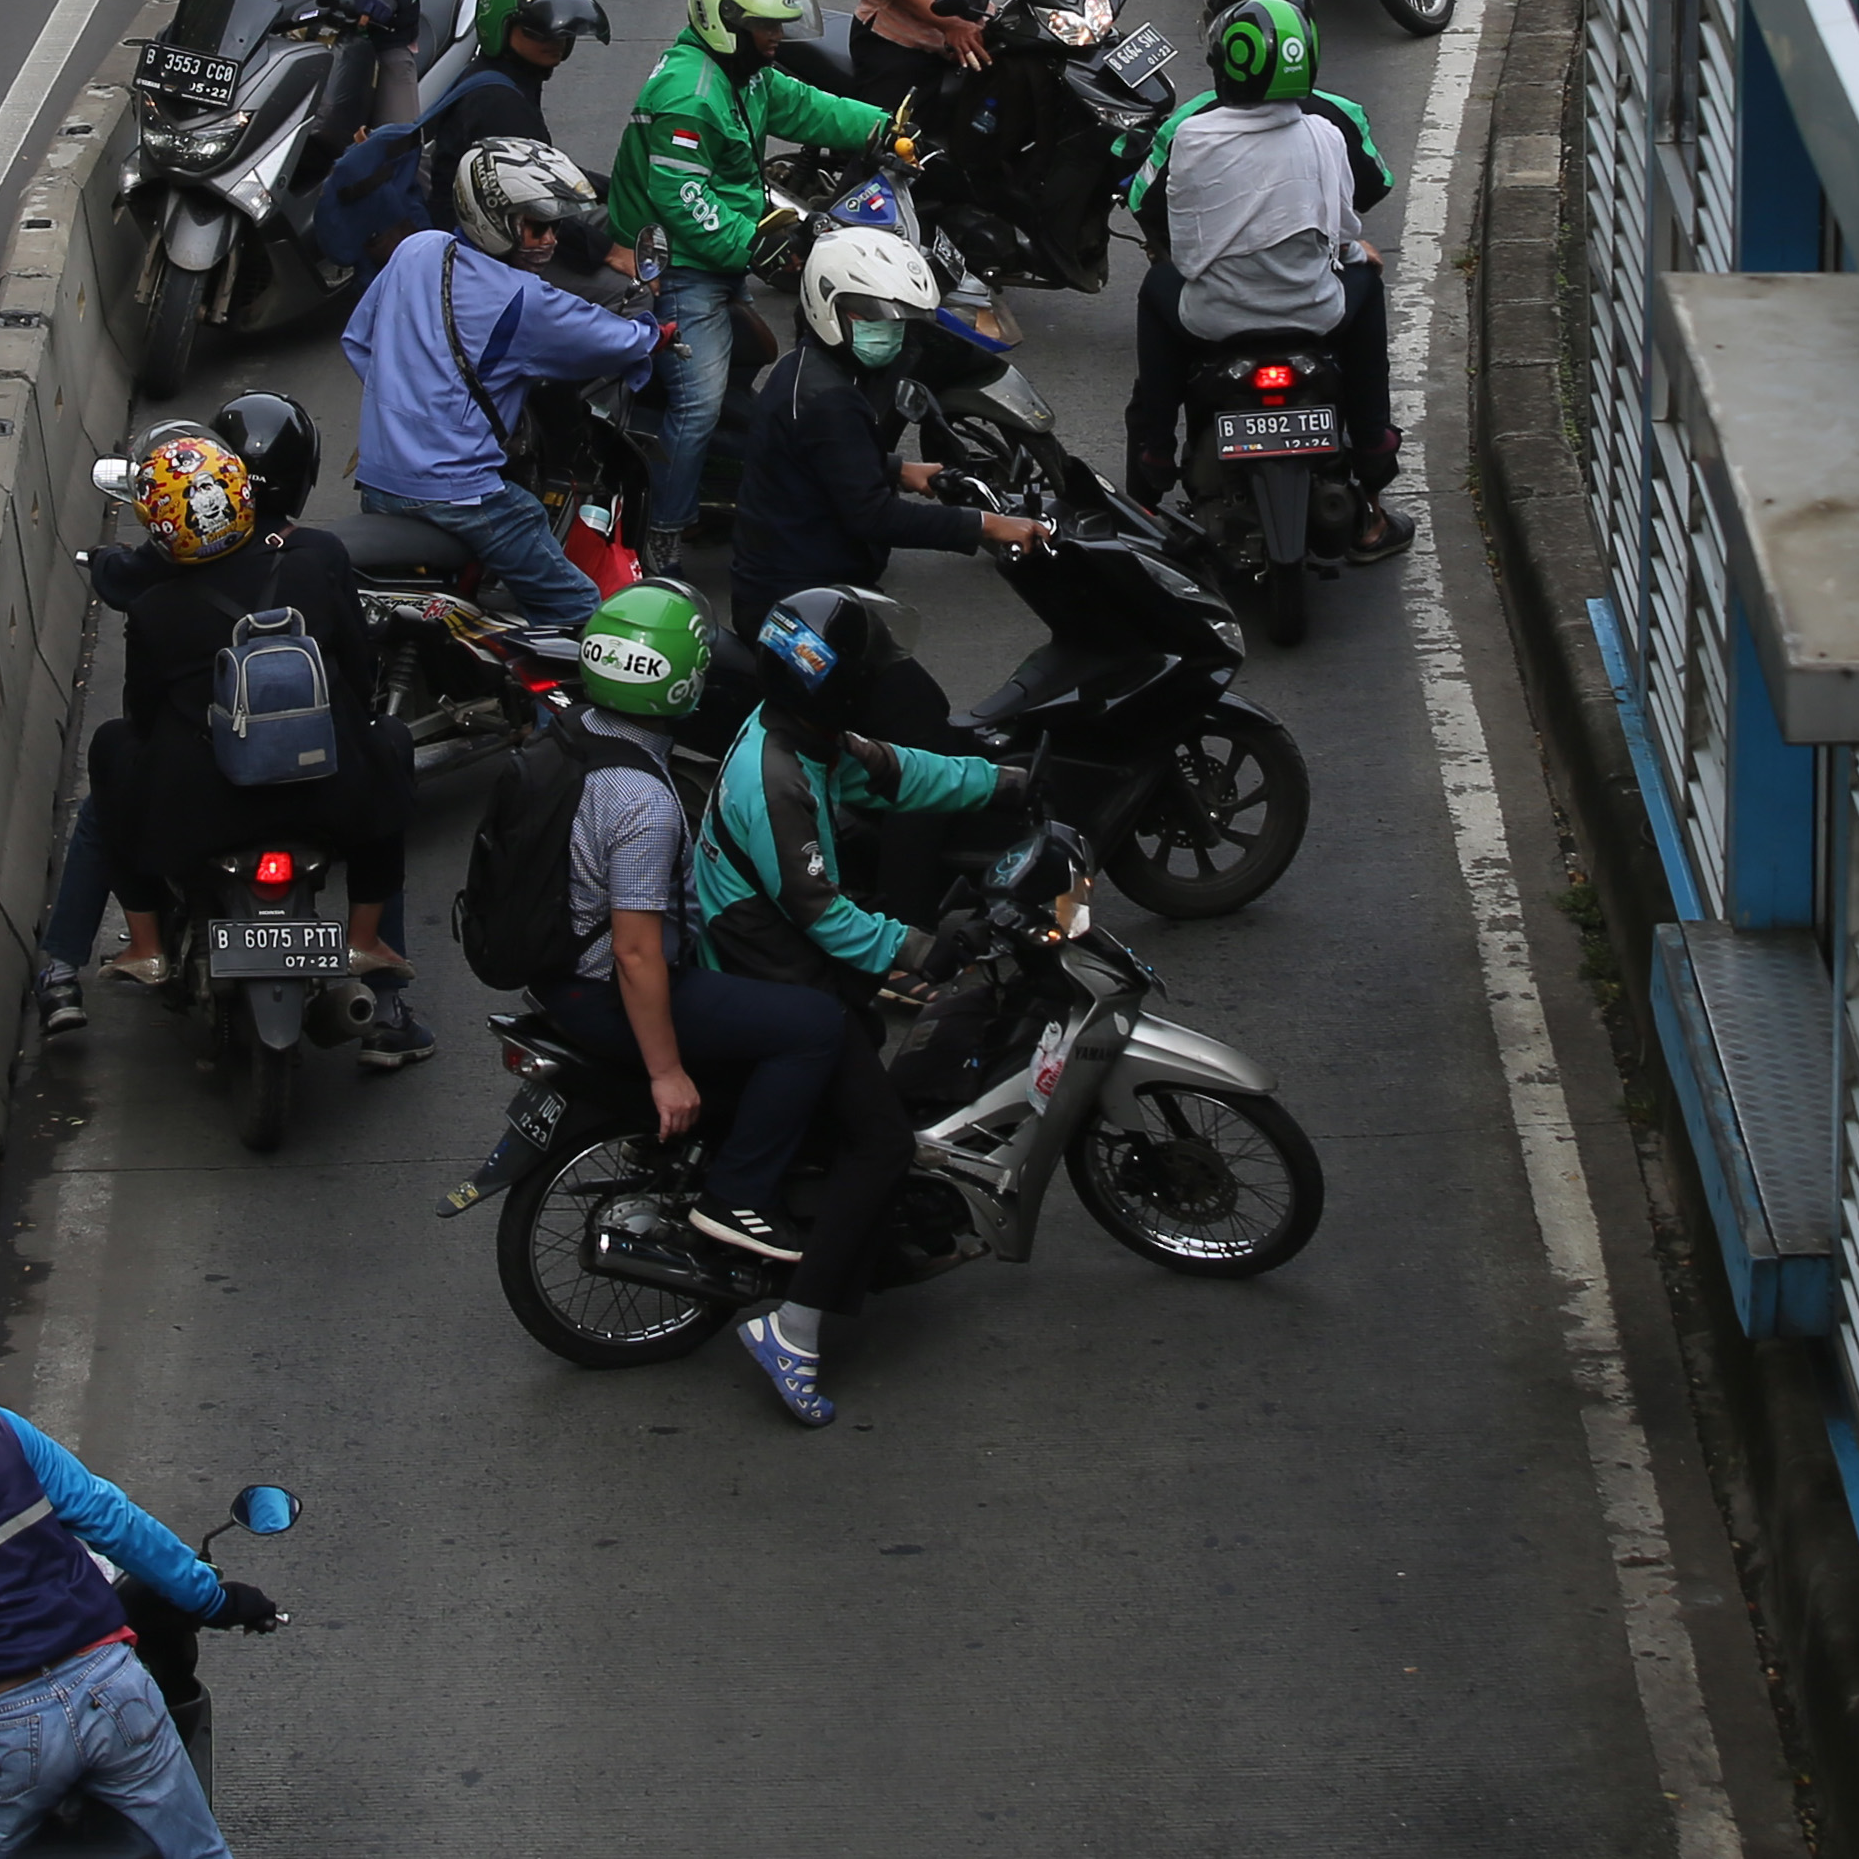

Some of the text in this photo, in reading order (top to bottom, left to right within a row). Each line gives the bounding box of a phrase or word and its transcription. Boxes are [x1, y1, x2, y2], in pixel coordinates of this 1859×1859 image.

[145, 48, 157, 65] B
[163, 53, 201, 76] 3553
[679, 180, 719, 232] Grab
[1223, 412, 1332, 437] B 5892 TEU
[623, 653, 663, 679] JEK
[216, 926, 340, 950] B 6075 PTT
